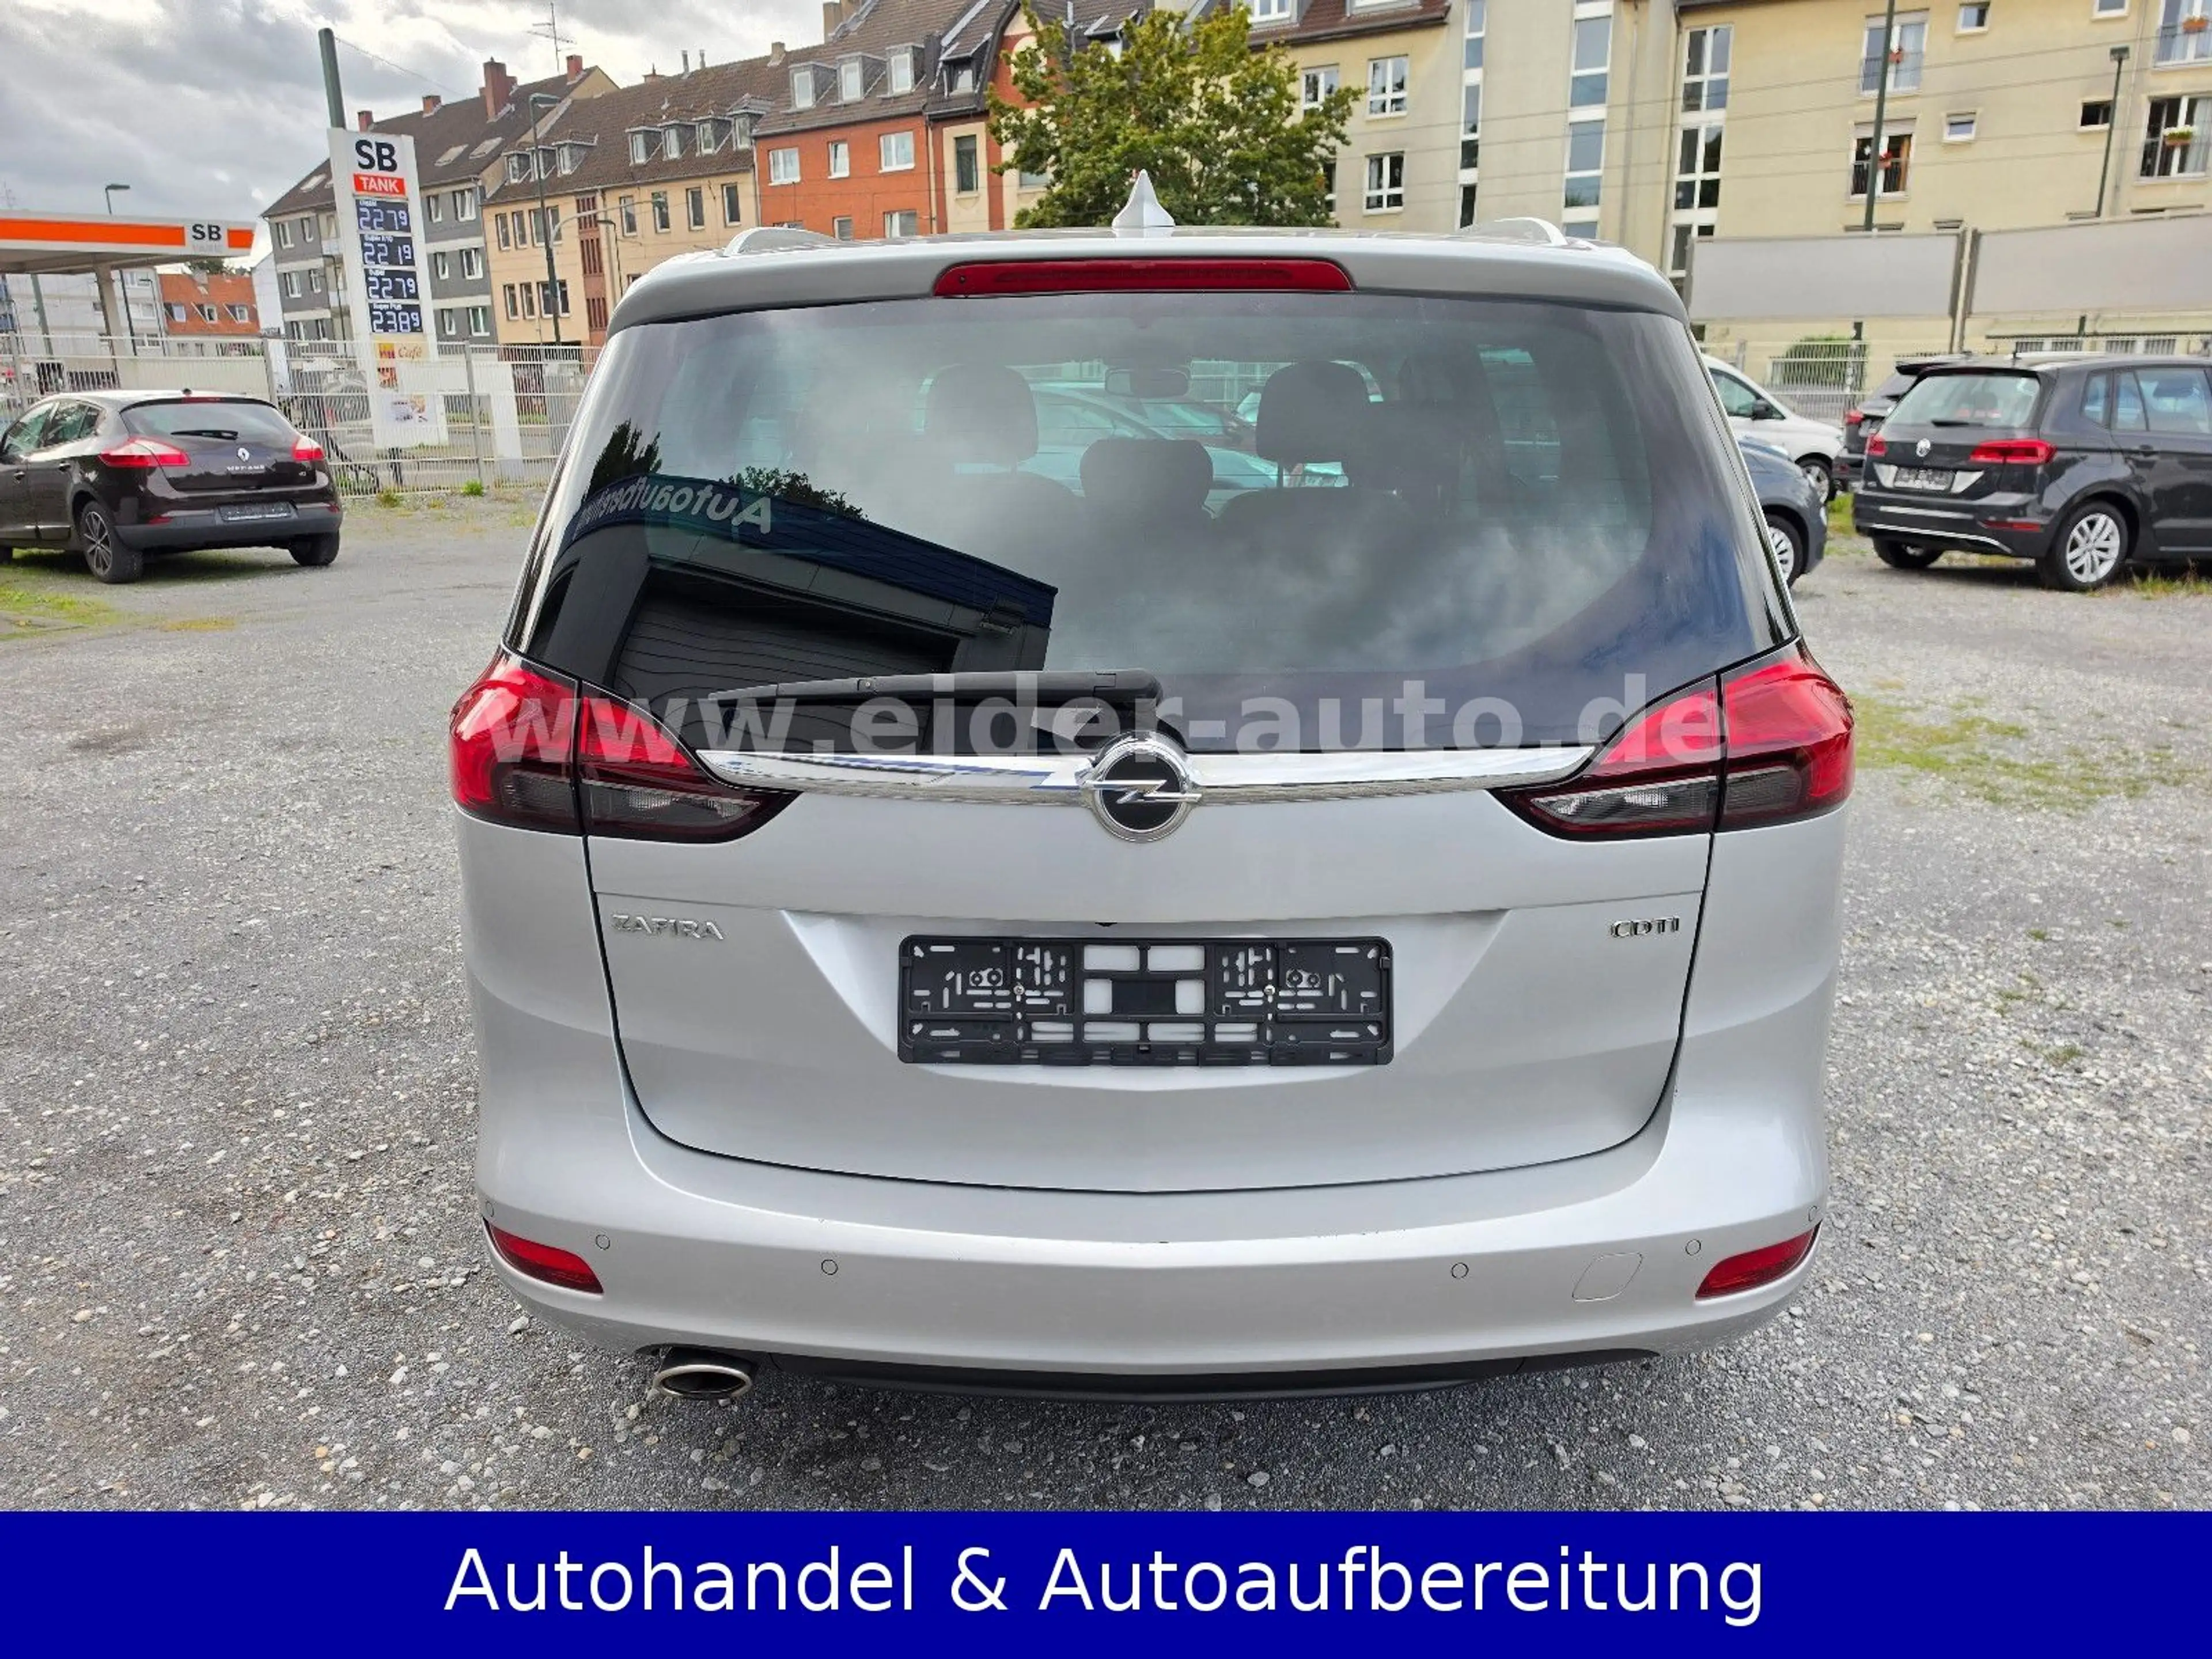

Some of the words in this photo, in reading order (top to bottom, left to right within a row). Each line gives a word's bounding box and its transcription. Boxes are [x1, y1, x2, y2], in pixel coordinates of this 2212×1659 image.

[355, 139, 397, 172] SB
[359, 176, 400, 193] TANK
[359, 207, 408, 230] 2279
[192, 224, 222, 241] SB
[363, 243, 412, 265] 2219
[368, 277, 416, 298] 2279
[372, 311, 420, 332] 2389
[612, 913, 724, 940] ZAFIRA
[1611, 915, 1680, 938] CDTI
